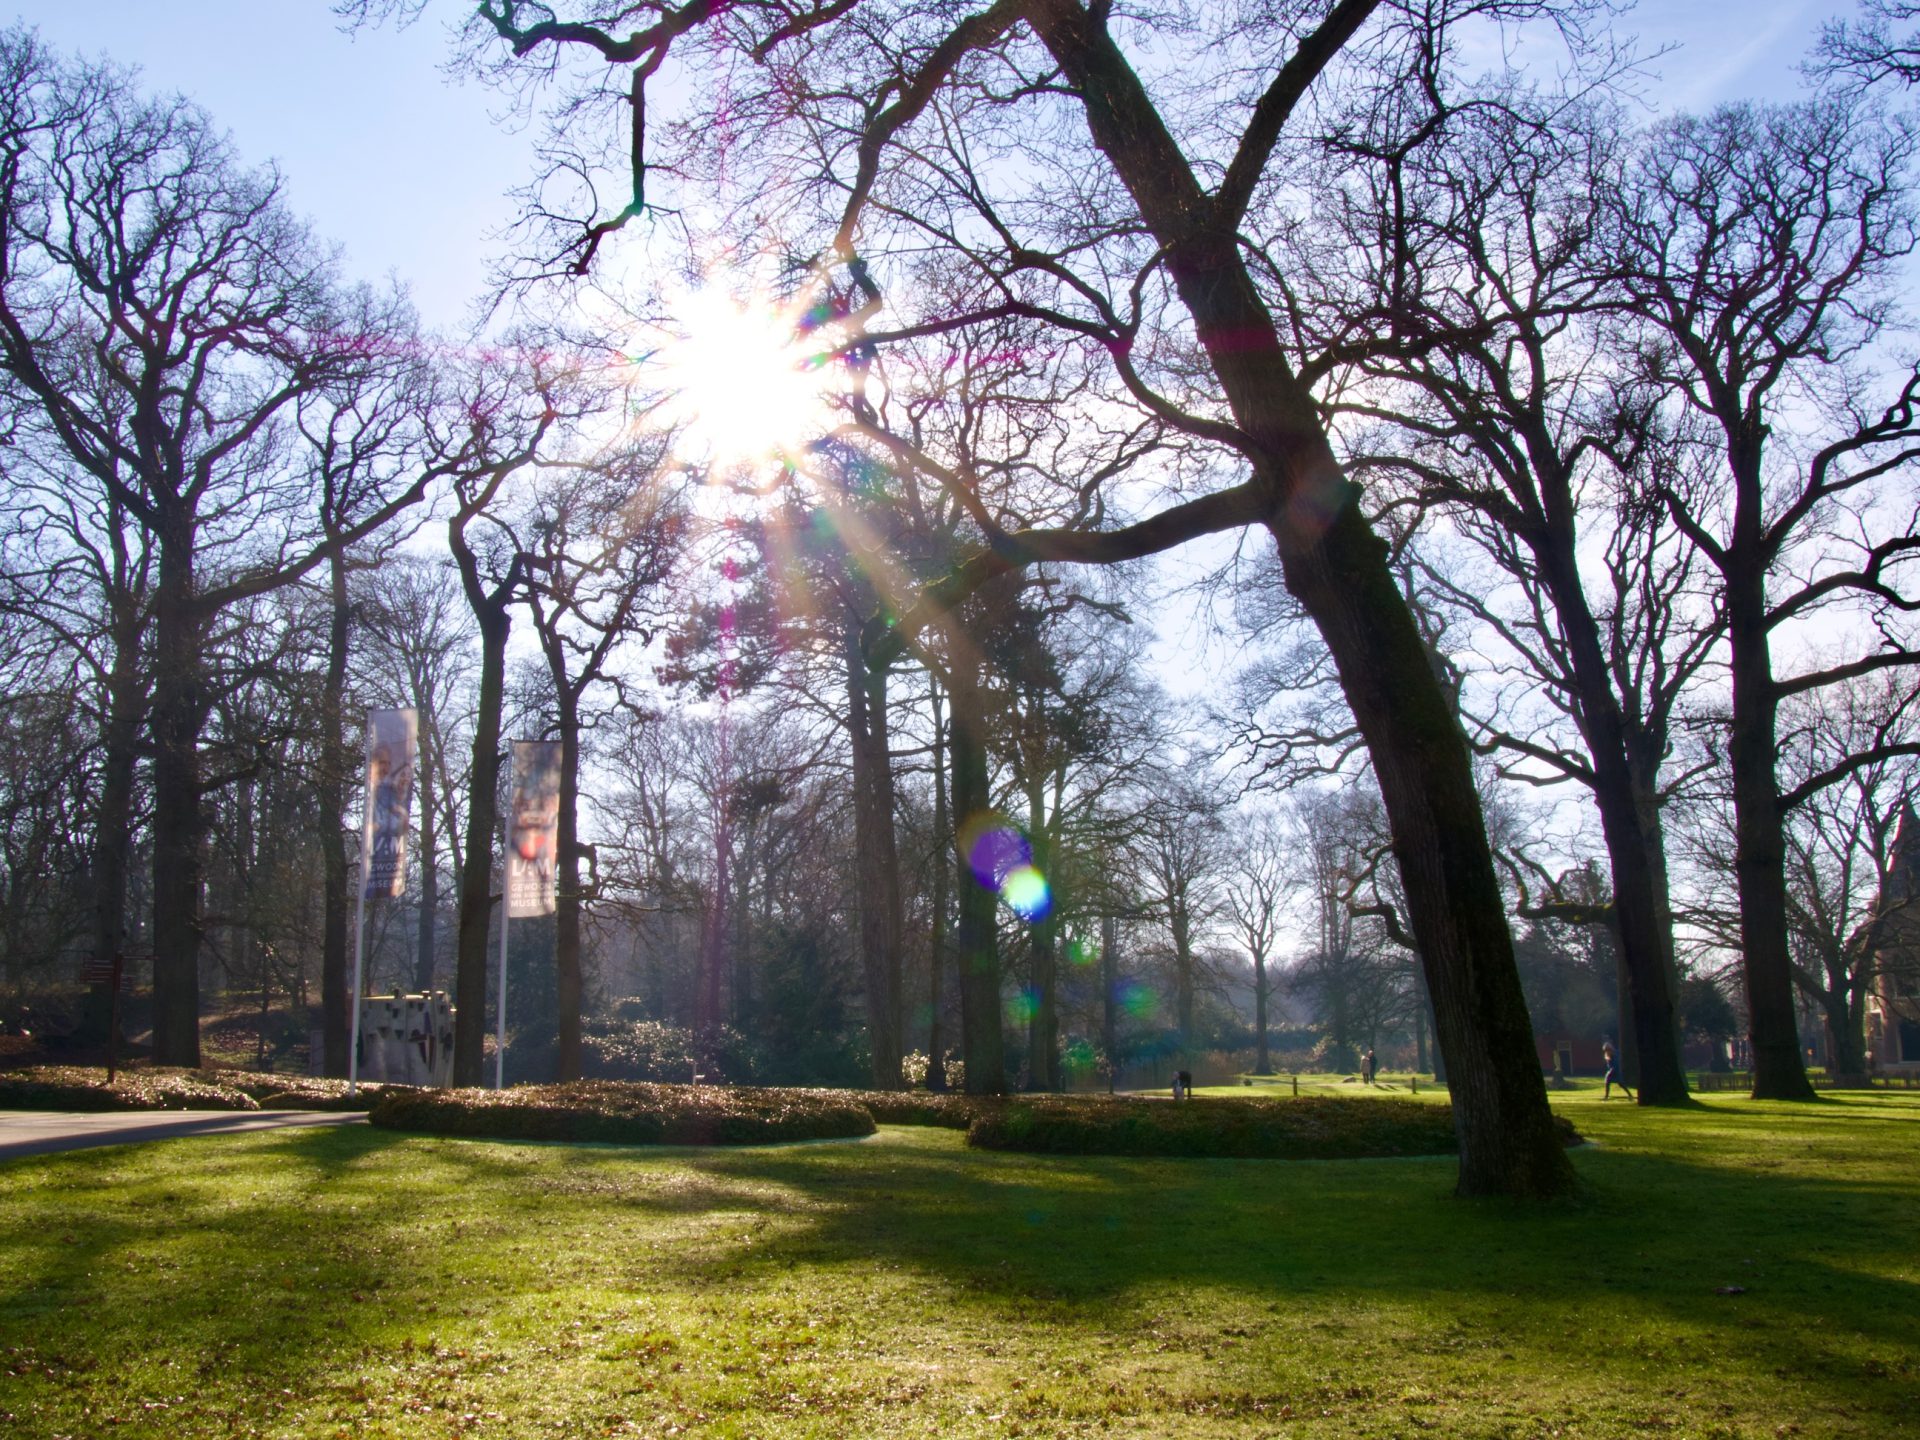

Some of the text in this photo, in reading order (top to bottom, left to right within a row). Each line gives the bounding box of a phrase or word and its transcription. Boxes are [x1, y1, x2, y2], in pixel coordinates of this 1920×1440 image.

[367, 861, 403, 872] EWOON
[367, 878, 403, 889] MSEUM
[511, 881, 552, 892] GEWOON
[511, 897, 552, 908] MUSEUM
